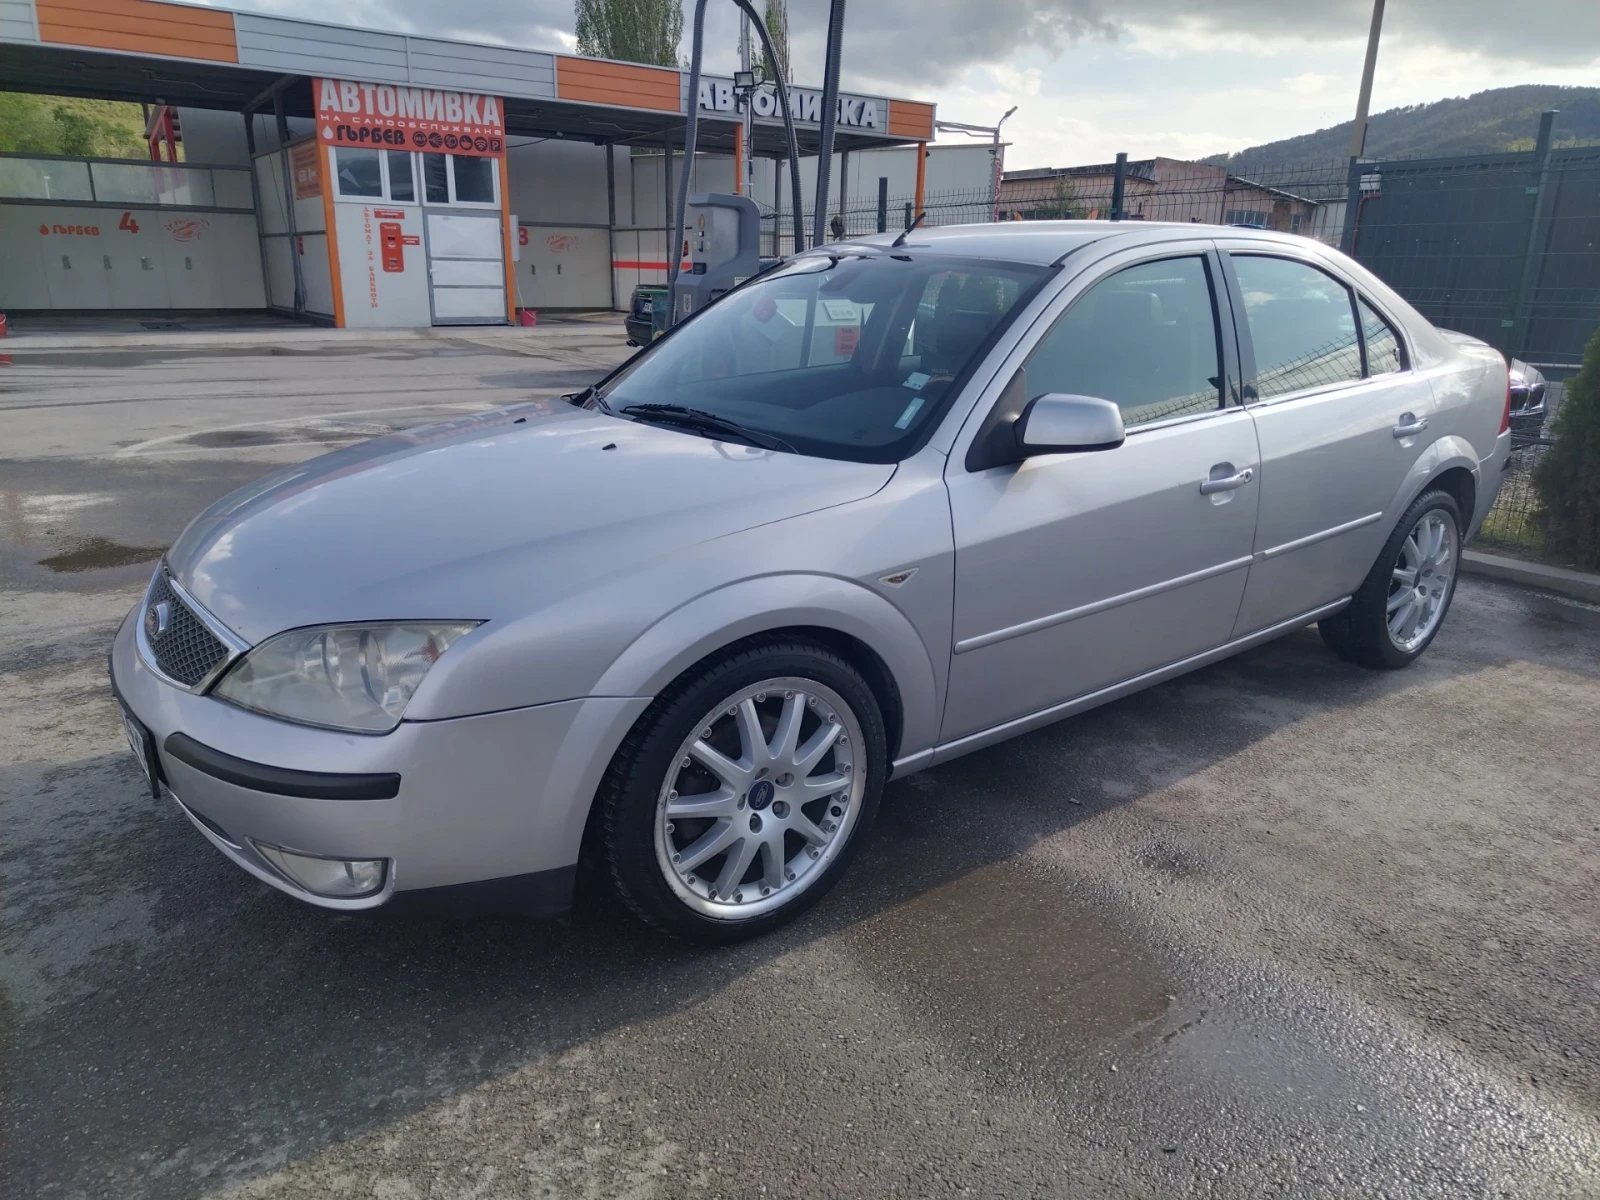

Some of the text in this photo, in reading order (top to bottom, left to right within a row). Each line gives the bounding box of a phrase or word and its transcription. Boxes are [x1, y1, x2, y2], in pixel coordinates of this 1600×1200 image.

[320, 78, 501, 127] АВТОМИВКА
[698, 80, 879, 128] АВТОМИКА
[320, 114, 502, 136] НА САМООБСЛУЖВАНЕ
[336, 124, 406, 145] ГЪРБЕВ
[52, 224, 100, 236] ГЪРБЕВ
[118, 211, 140, 234] 4
[518, 226, 529, 246] 3
